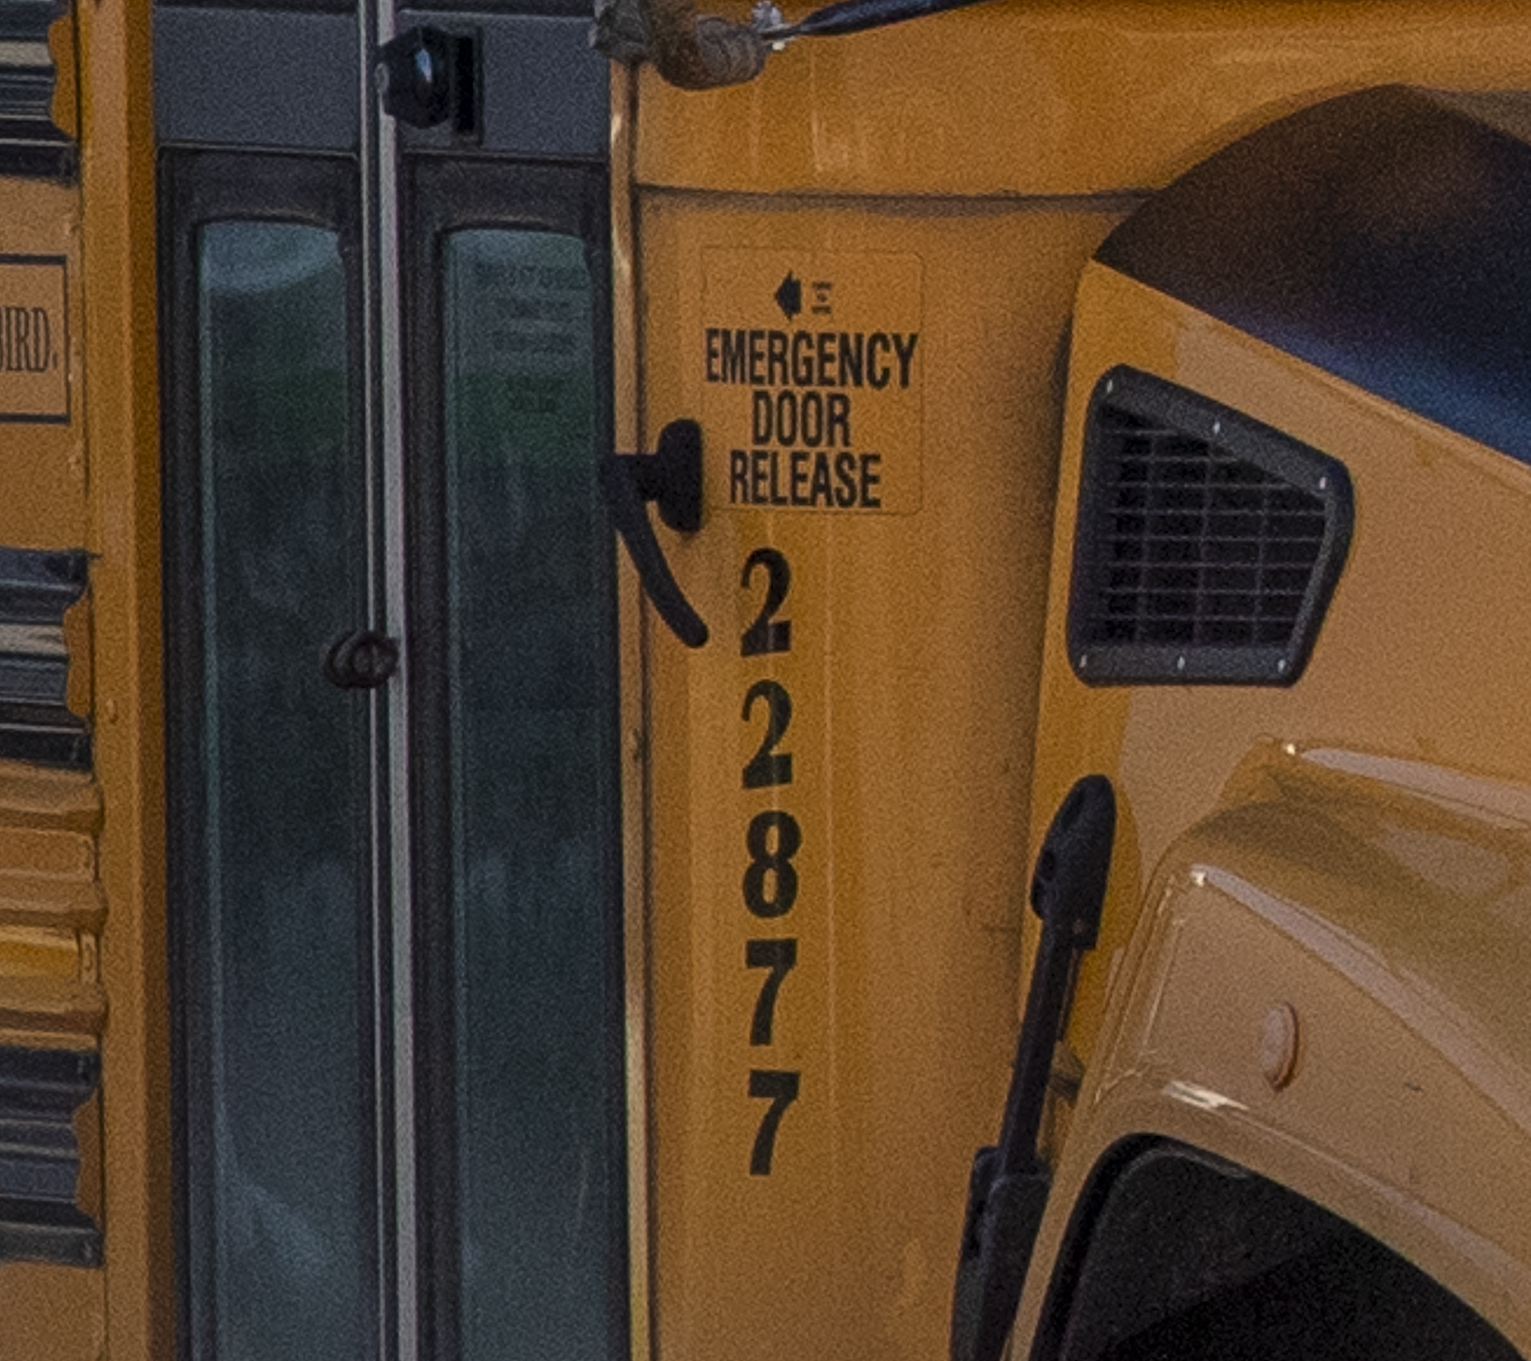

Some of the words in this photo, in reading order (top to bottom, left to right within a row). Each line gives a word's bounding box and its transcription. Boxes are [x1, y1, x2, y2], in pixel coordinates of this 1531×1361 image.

[705, 327, 919, 390] EMERGENCY
[752, 389, 852, 448] DOOR
[729, 448, 882, 509] RELEASE
[739, 547, 802, 1177] 22877
